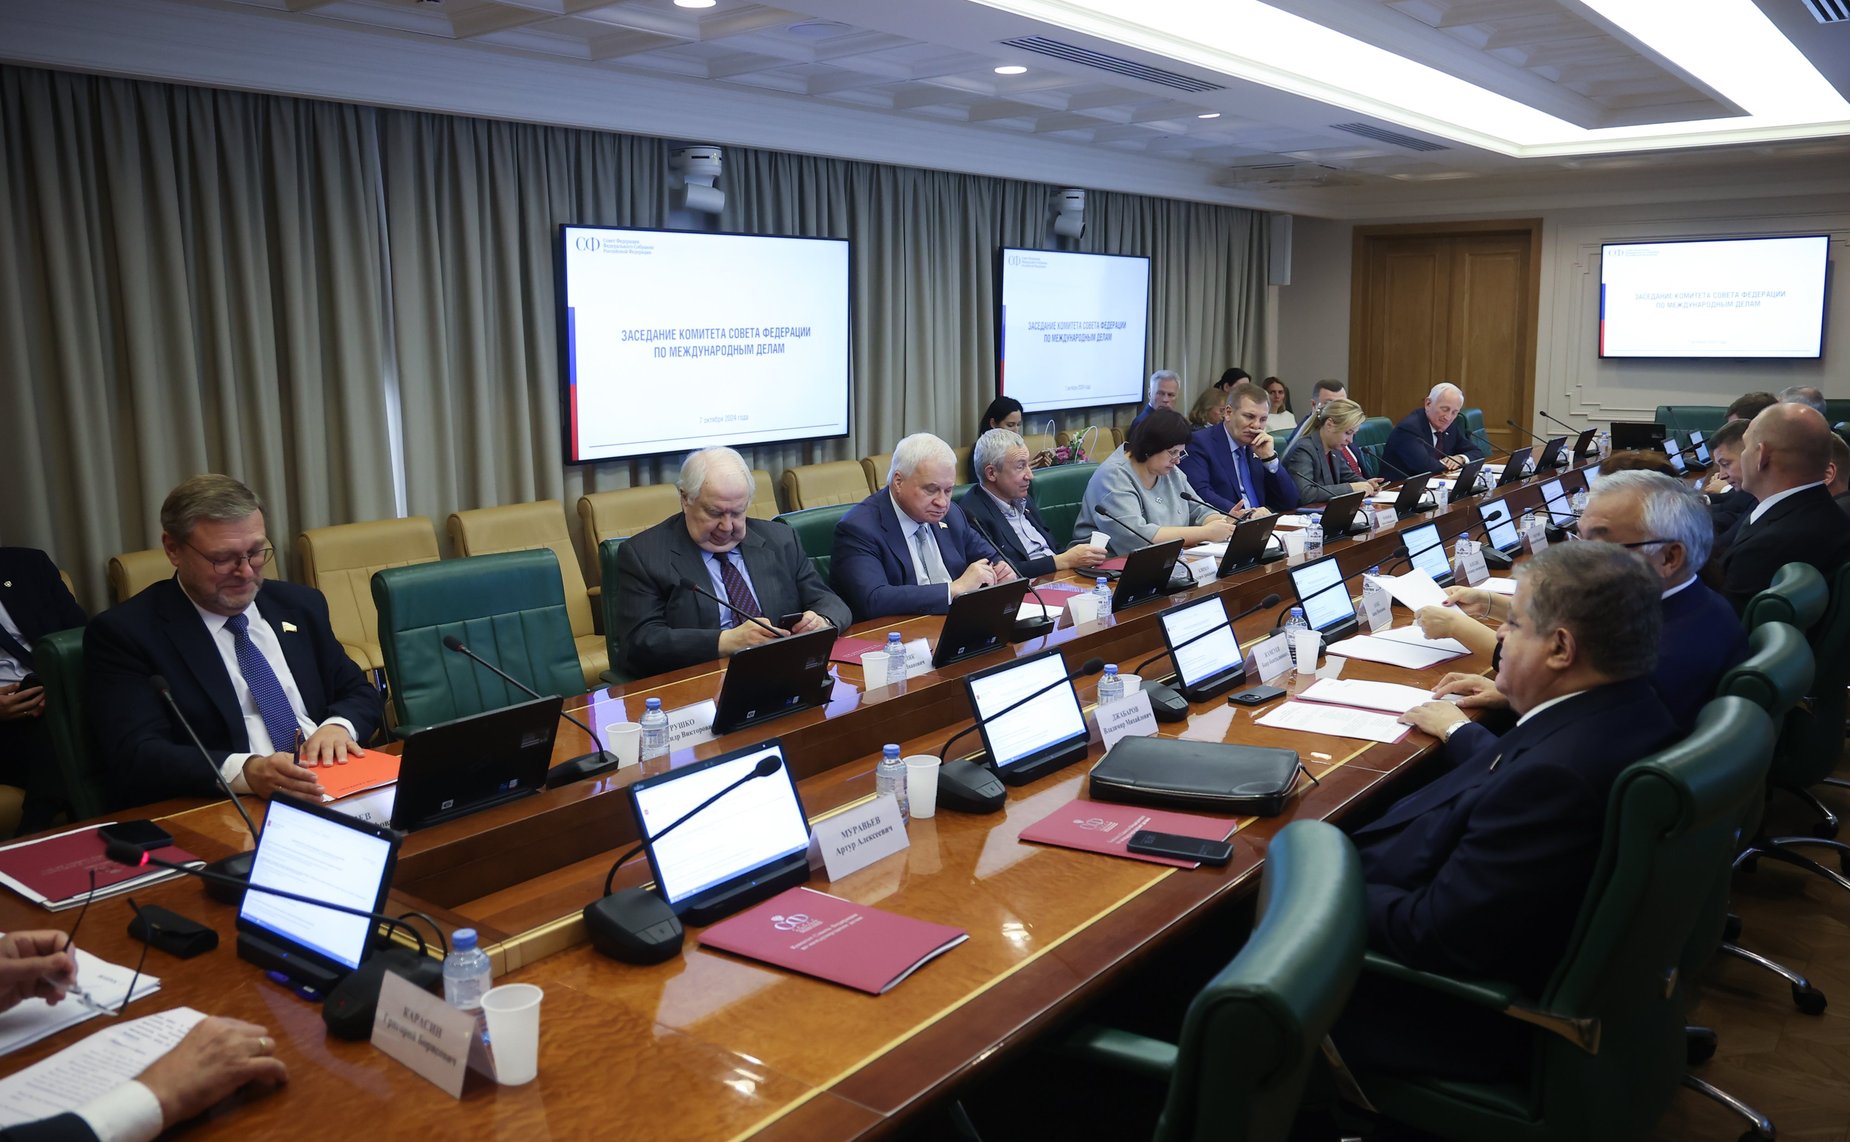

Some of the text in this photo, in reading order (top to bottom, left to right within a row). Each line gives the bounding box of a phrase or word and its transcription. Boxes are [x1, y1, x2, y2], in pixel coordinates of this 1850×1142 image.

[575, 236, 600, 252] СФ
[1741, 289, 1786, 299] ФЕДЕРАЦИИ
[1667, 300, 1734, 310] МЕЖДУНАРОДНЫМ
[1735, 300, 1761, 309] ДЕЛАМ
[621, 325, 811, 343] ЗАСЕДАНИЕ КОМИТЕТА СОВЕТА ФЕДЕРАЦИИ
[654, 342, 785, 359] ПО МЕЖДУНАРОДНЫМ ДЕЛАМ
[1112, 705, 1139, 722] ДЖАБАРОВ
[669, 718, 695, 731] РУШКО
[681, 725, 712, 738] Викторови
[1103, 712, 1152, 735] Владимир Михайлович
[841, 816, 881, 840] МУРАВЬЕВ
[836, 825, 894, 857] Артур Алексеевич
[383, 1012, 417, 1042] Григорий
[402, 1006, 443, 1039] КАРАСИН
